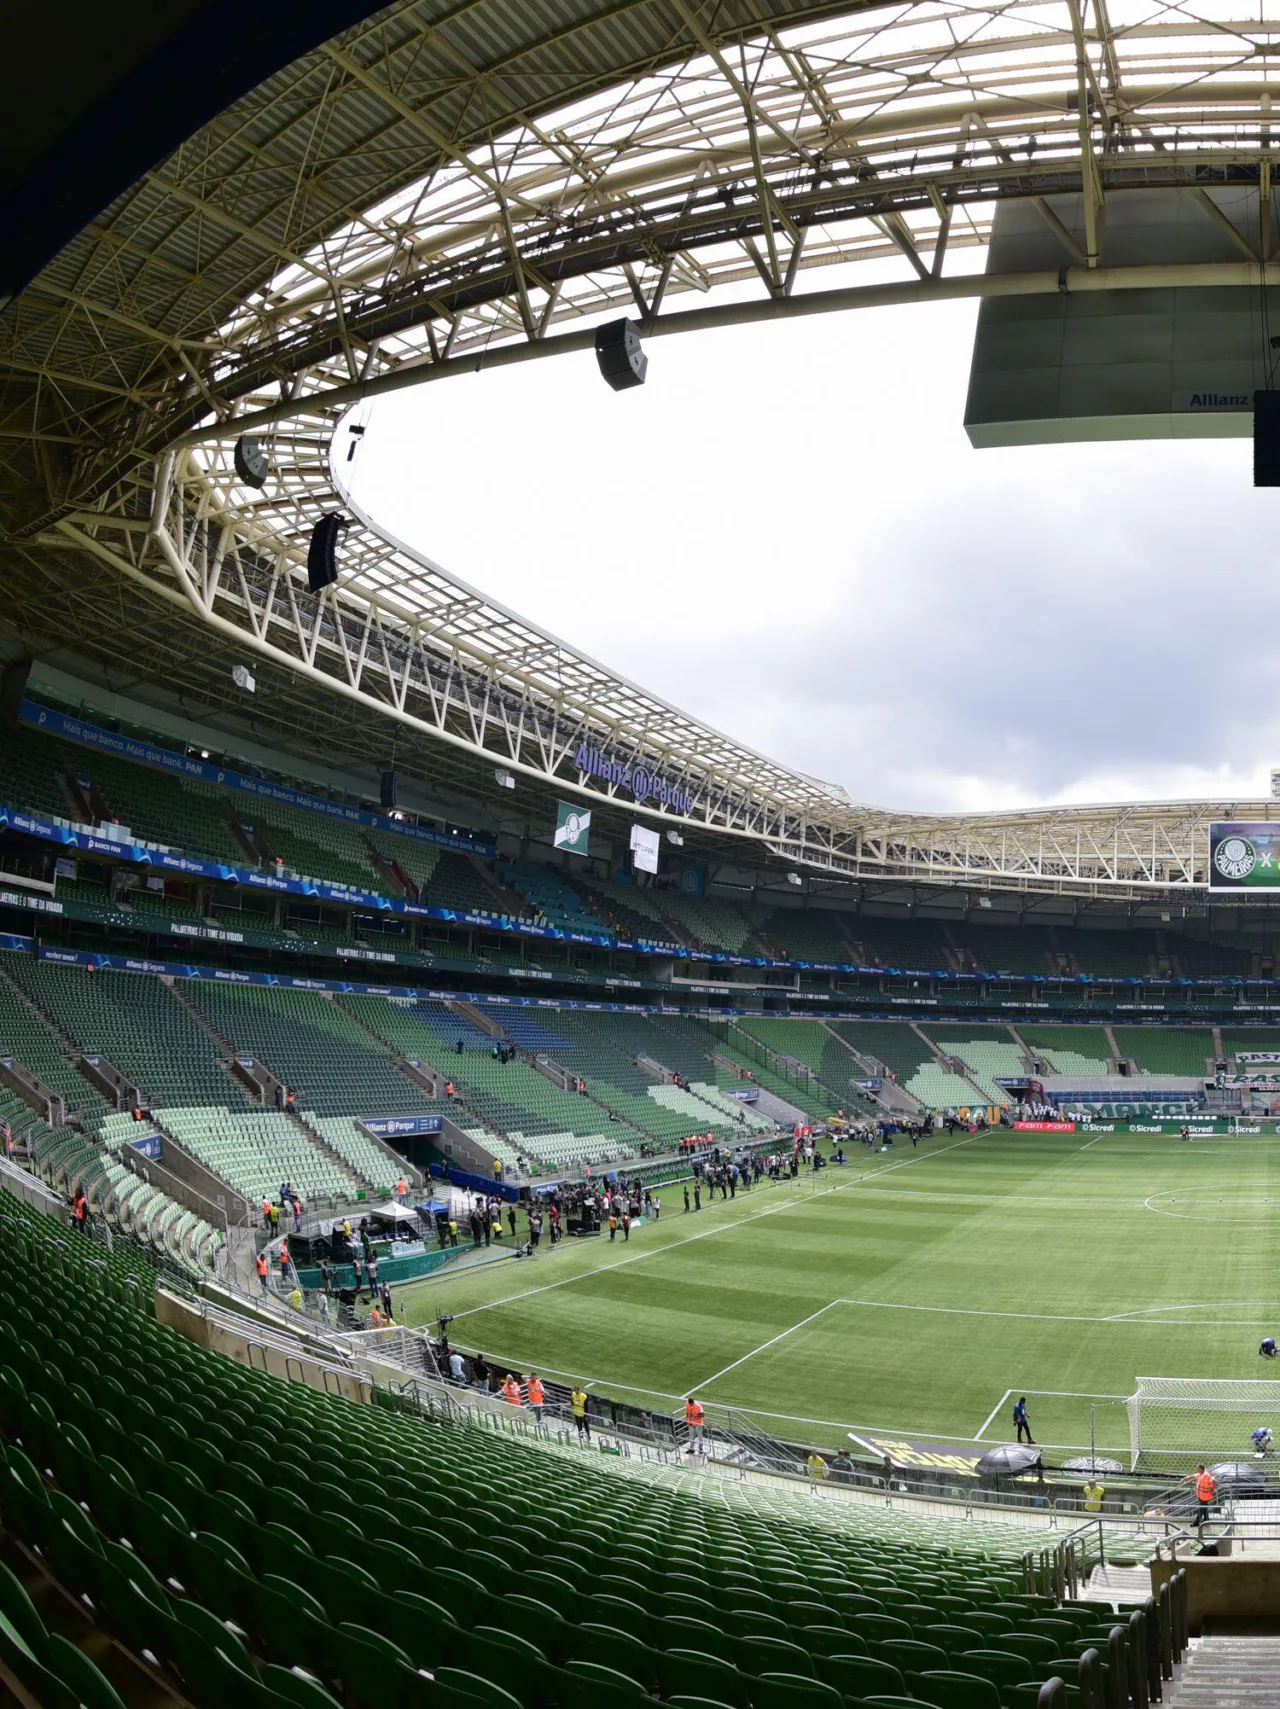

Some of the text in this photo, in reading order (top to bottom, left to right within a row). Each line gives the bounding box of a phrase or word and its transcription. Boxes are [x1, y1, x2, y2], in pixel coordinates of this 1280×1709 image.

[1190, 394, 1249, 407] Allianz
[63, 720, 202, 775] Mais que banco. Mais que bank. PAN
[574, 743, 694, 816] Allianz Parque
[239, 778, 256, 791] Mais
[258, 785, 271, 796] que
[272, 787, 294, 801] banco.
[296, 795, 311, 807] Mais
[313, 800, 325, 811] que
[345, 810, 360, 820] PAN
[13, 817, 51, 835] Allianz Seguros
[94, 841, 121, 853] BANCO PAN
[163, 856, 203, 871] Allianz Seguros
[1217, 855, 1254, 876] PALMEIRAS
[249, 874, 287, 888] Allianz Parque
[0, 891, 18, 905] MEIRAS
[27, 897, 38, 909] TIME
[38, 899, 45, 910] DA
[45, 900, 63, 913] VIRADA
[330, 890, 363, 902] Allianz Seguros
[171, 923, 198, 936] PALMEIRAS
[207, 928, 218, 938] TIME
[219, 930, 226, 939] DA
[226, 931, 244, 942] VIRADA
[336, 947, 358, 958] PALMEIRAS
[126, 960, 165, 972] Allianz Seguros
[215, 971, 249, 981] Allianz Parque
[365, 1121, 414, 1131] Allianz Parque
[1089, 1124, 1114, 1132] Sicredi
[1136, 1124, 1162, 1132] Sicredi
[1188, 1125, 1214, 1133] Sicredi
